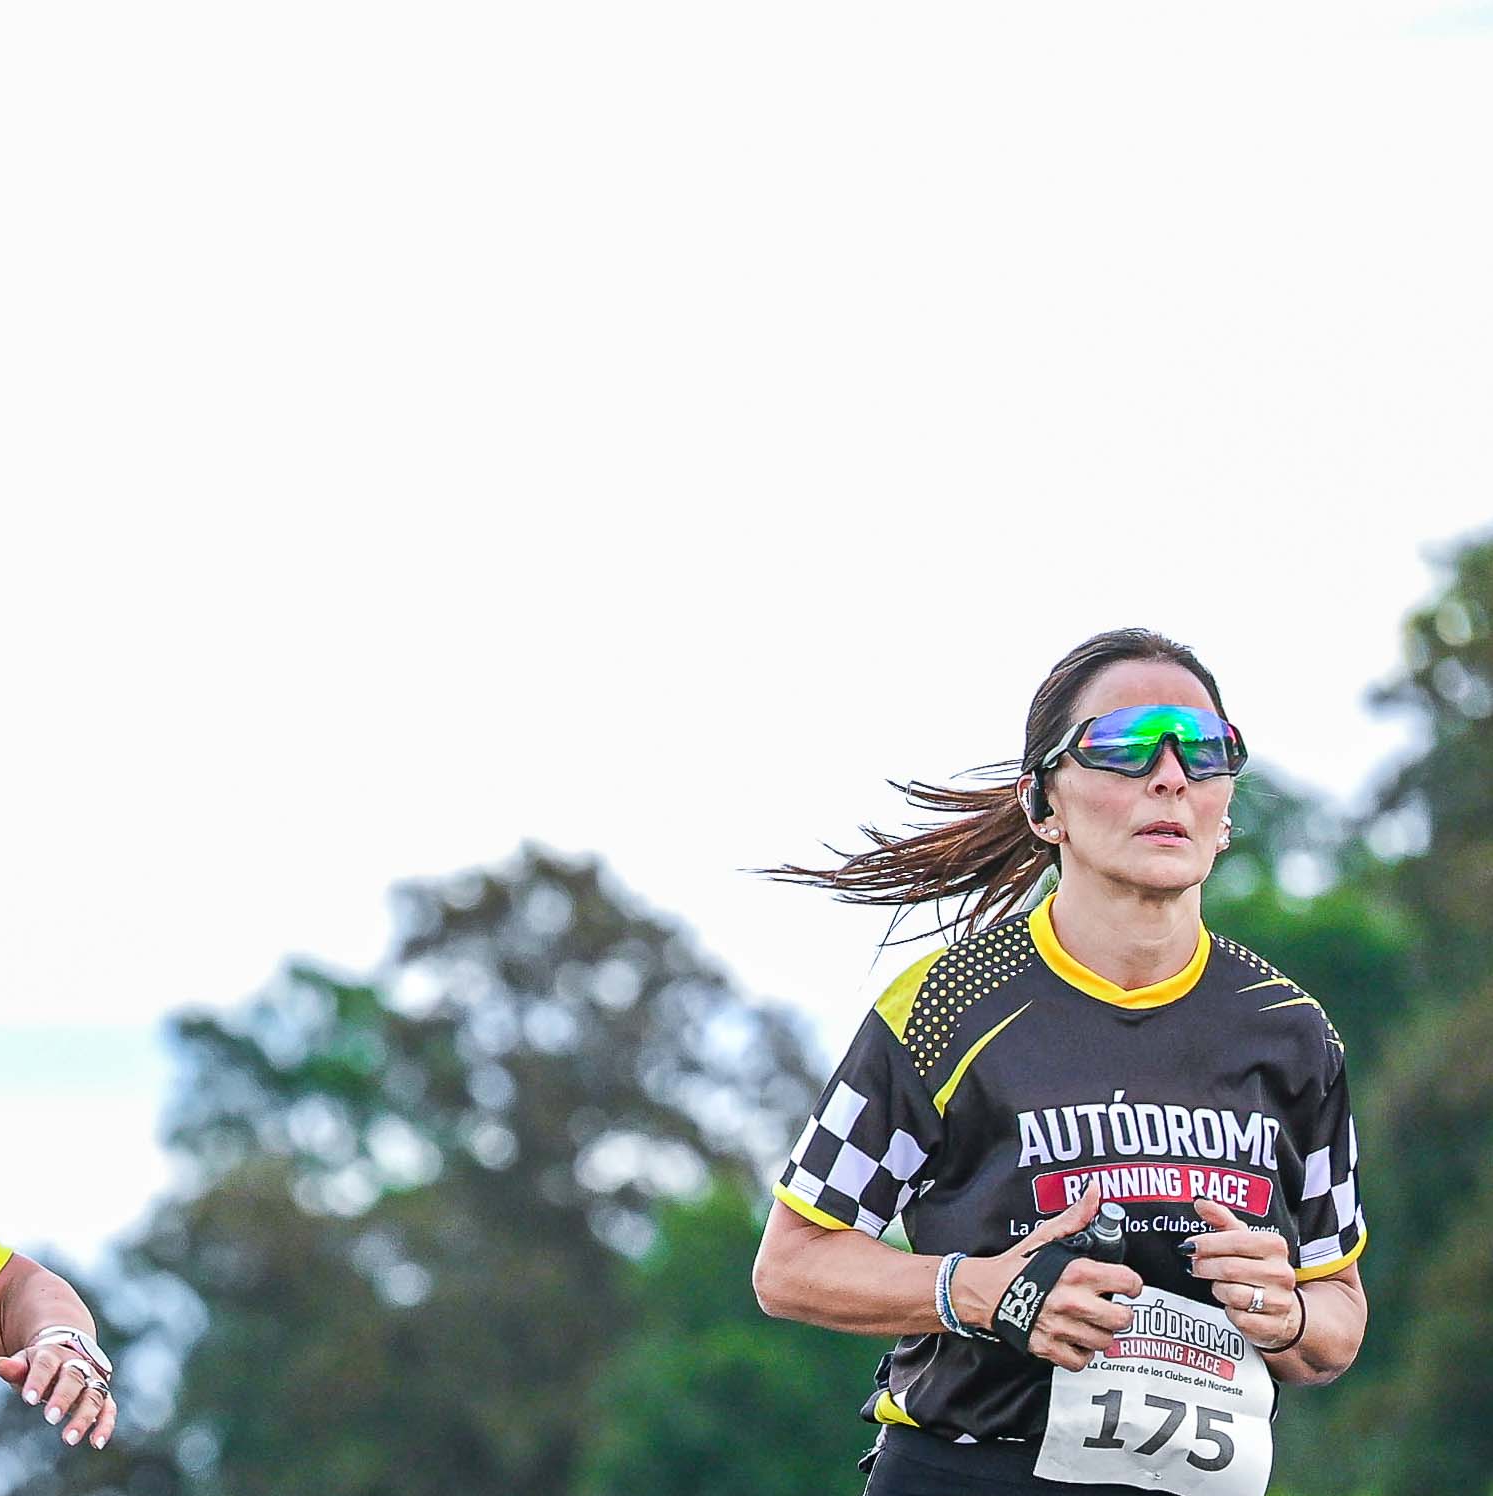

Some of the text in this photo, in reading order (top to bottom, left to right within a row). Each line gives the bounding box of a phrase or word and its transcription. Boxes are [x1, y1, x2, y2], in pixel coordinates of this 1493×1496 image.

[1016, 1089, 1280, 1171] AUTÓDROMO
[1188, 1169, 1250, 1208] RACE
[1010, 1219, 1029, 1236] La
[1125, 1215, 1149, 1232] los
[1153, 1216, 1206, 1234] Clubes
[1113, 1299, 1244, 1361] TÓDROMO
[1119, 1339, 1222, 1374] RUNNING RACE
[1100, 1361, 1135, 1373] Carrera
[1137, 1365, 1149, 1375] de
[1151, 1367, 1163, 1378] los
[1165, 1370, 1193, 1385] Clubes
[1194, 1376, 1207, 1388] del
[1208, 1380, 1244, 1396] Noroeste
[1082, 1388, 1235, 1473] 175
